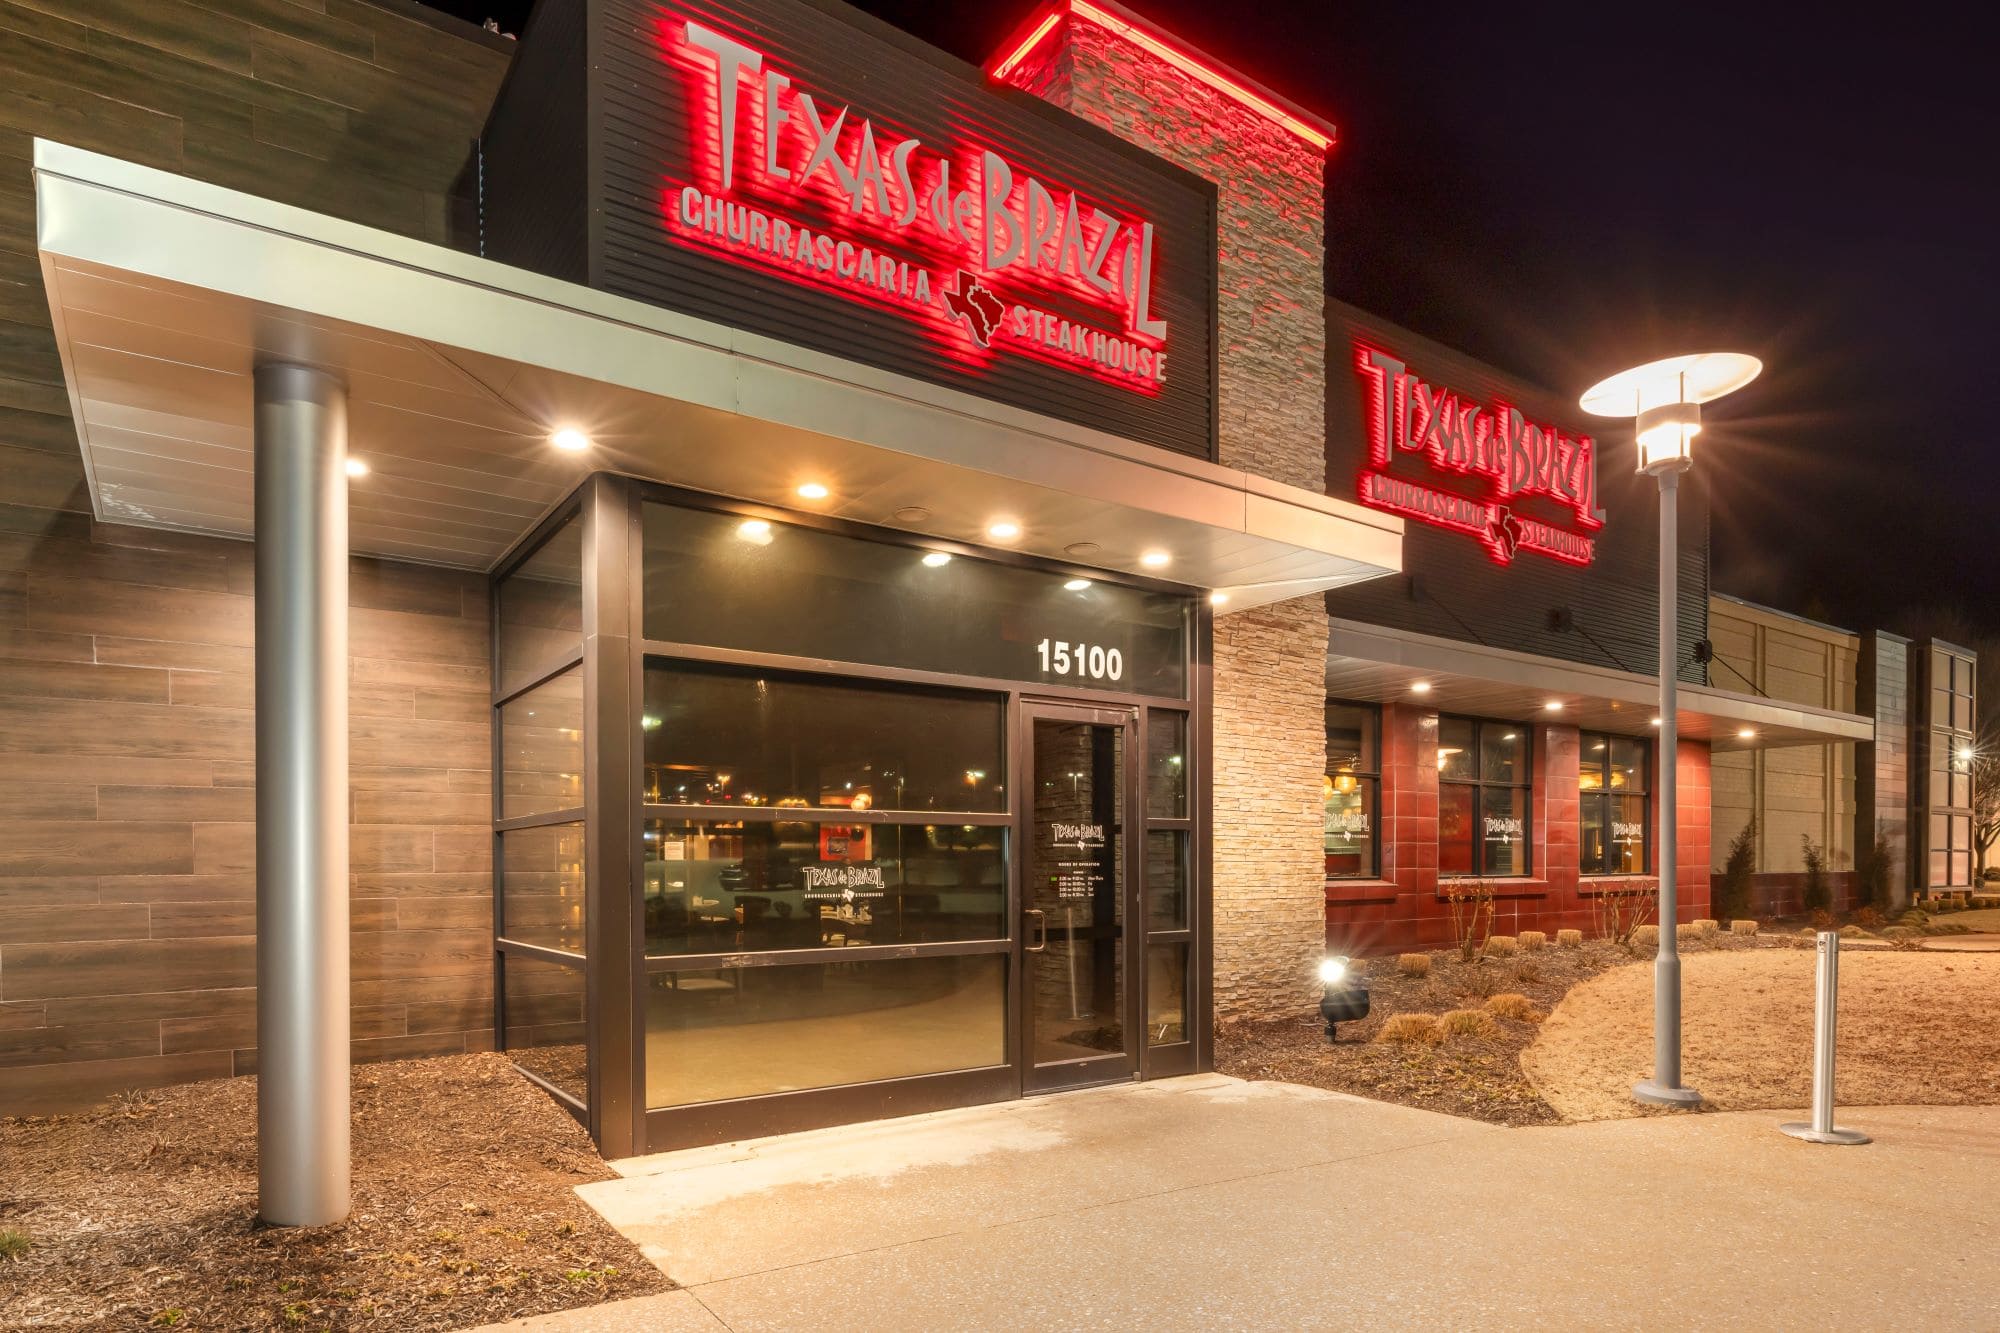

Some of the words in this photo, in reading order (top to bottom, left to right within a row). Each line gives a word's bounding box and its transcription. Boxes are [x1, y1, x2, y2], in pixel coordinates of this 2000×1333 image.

[683, 20, 922, 227] TEXAS
[931, 158, 974, 243] de
[679, 186, 932, 304] CHURRASCARIA
[1013, 304, 1168, 383] STEAKHOUSE
[1368, 350, 1482, 470] TEXAS
[1486, 415, 1506, 475] de
[1372, 473, 1487, 531] CHURRASCARIA
[1521, 519, 1596, 561] STEAKHOUSE
[1037, 637, 1123, 681] 15100
[802, 866, 838, 891] TEXAS
